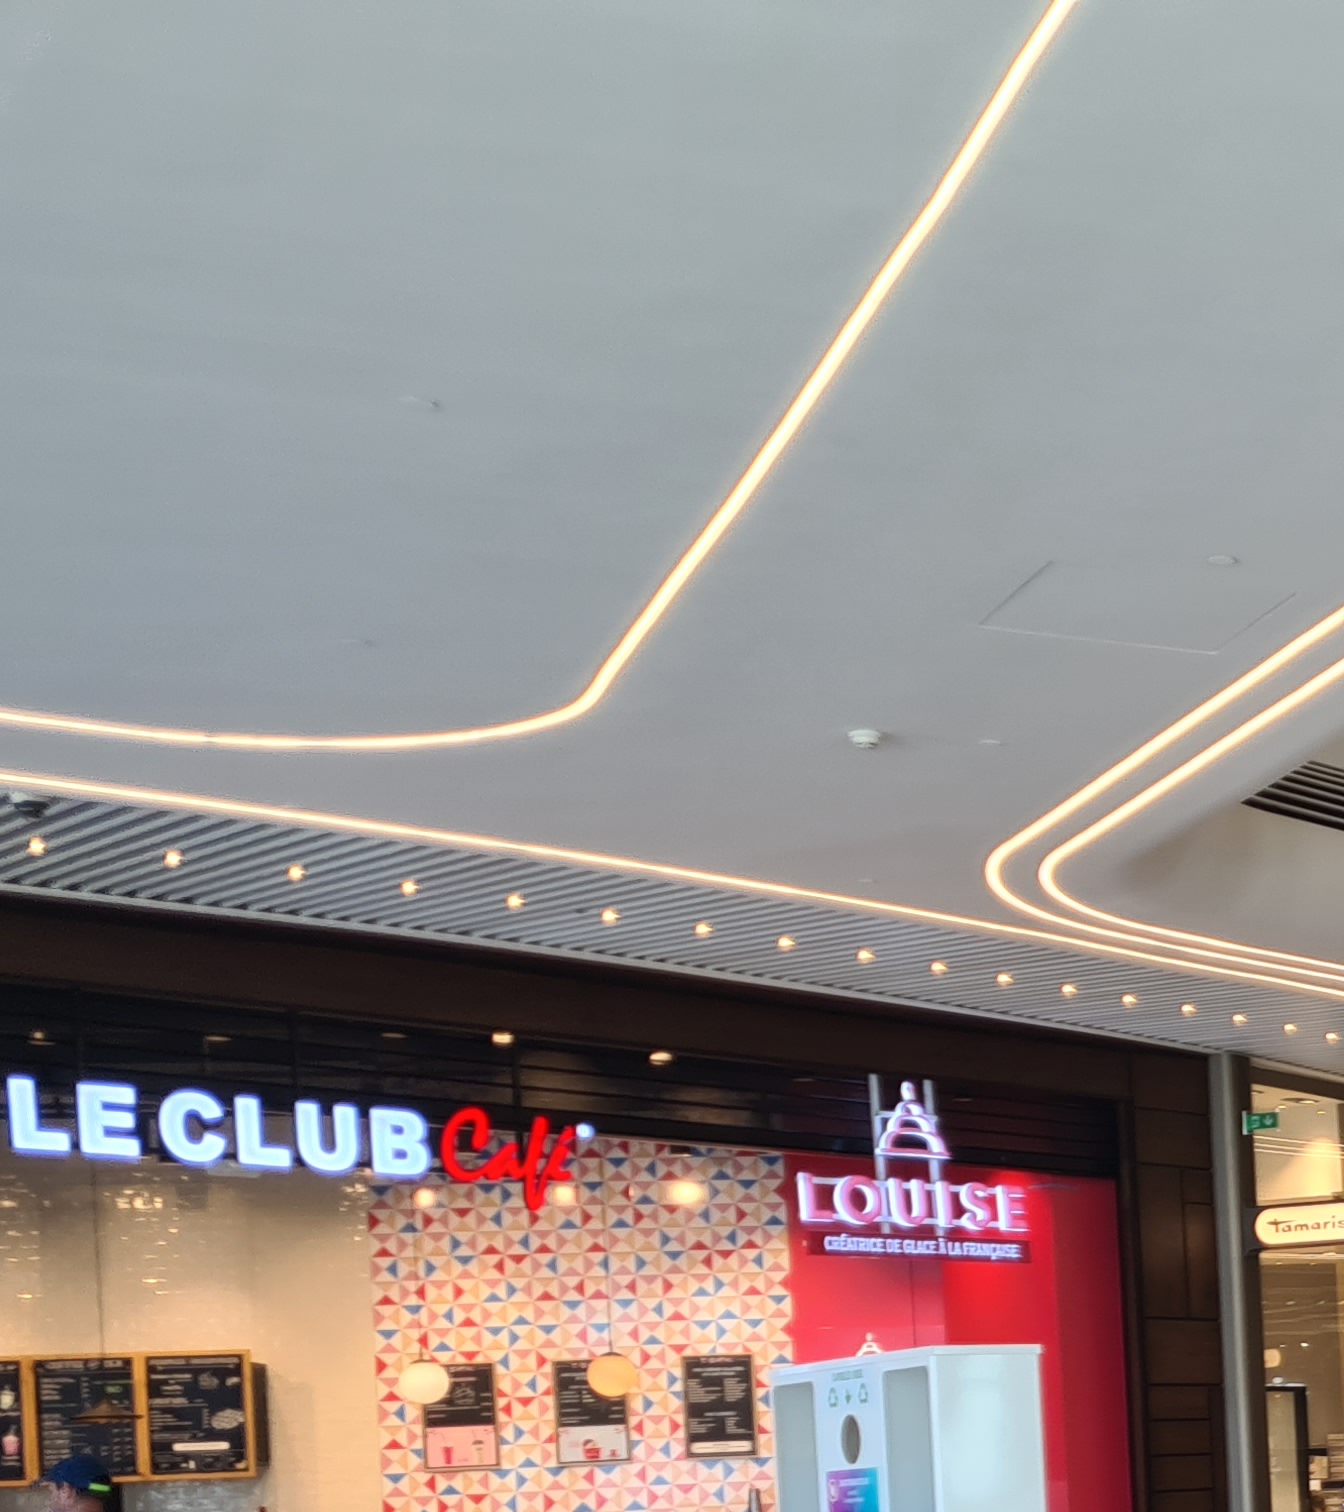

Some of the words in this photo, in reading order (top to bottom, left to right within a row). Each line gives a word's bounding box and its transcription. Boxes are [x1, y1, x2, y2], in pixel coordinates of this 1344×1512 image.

[6, 1074, 142, 1160] LE
[157, 1088, 432, 1177] CLUB
[441, 1106, 577, 1211] Café
[796, 1172, 1030, 1231] LOUISE
[824, 1234, 885, 1252] CRÉATRICE
[886, 1239, 902, 1253] DE
[903, 1239, 937, 1255] GLACE
[938, 1237, 947, 1255] À
[948, 1241, 962, 1256] LA
[963, 1243, 1023, 1260] FRANÇAISE
